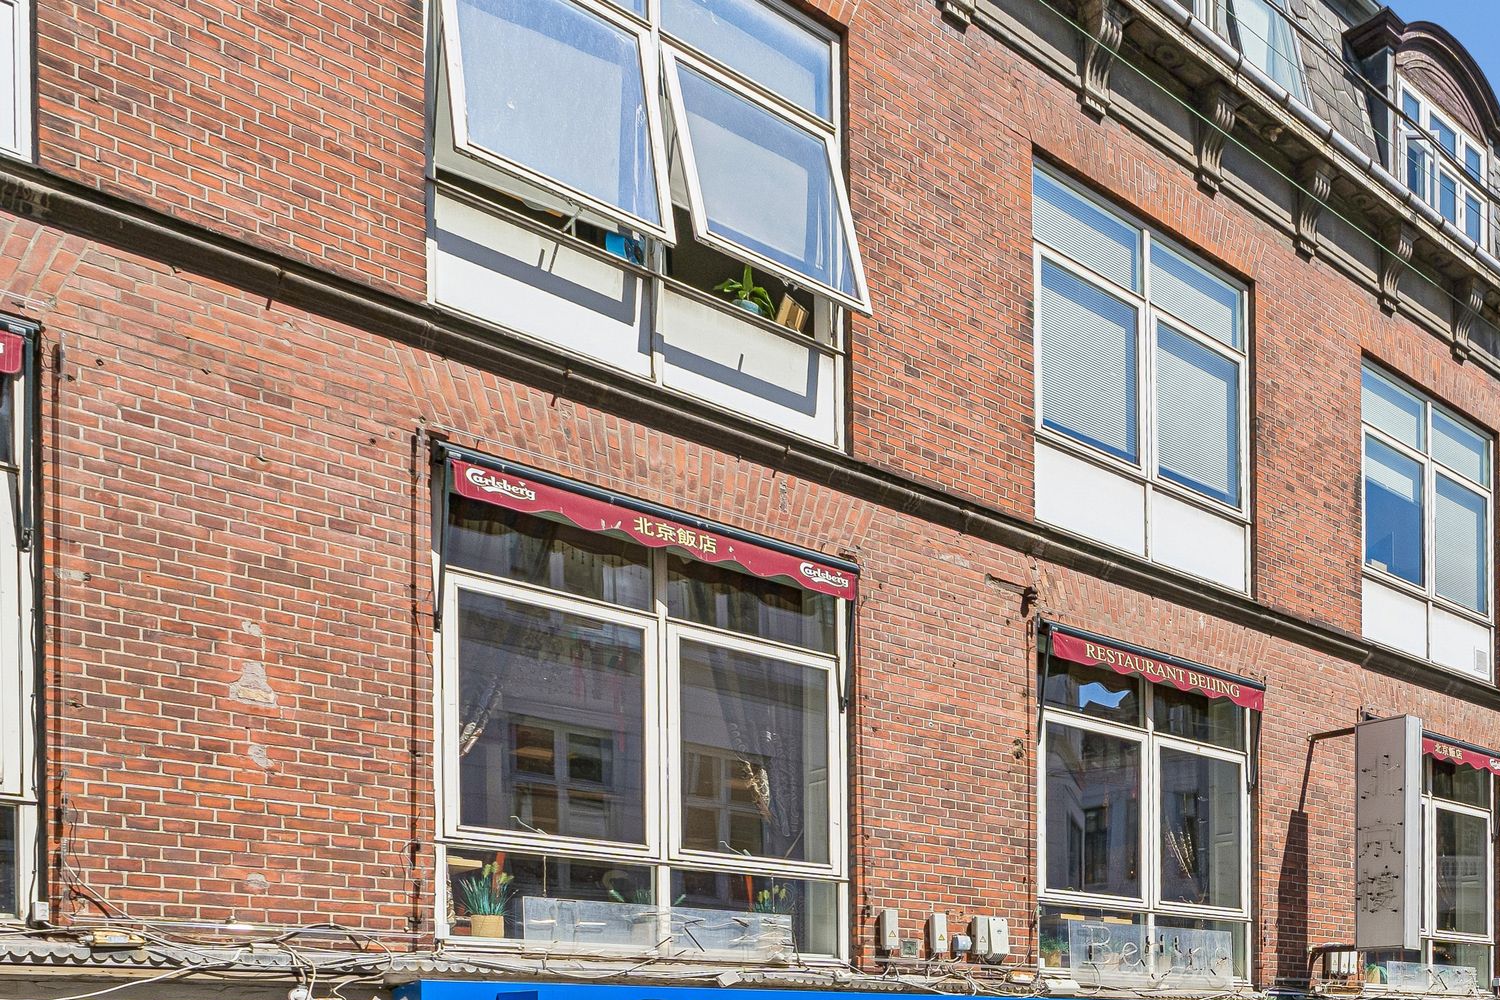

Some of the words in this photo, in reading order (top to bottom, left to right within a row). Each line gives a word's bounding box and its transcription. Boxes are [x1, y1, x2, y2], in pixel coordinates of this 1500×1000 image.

[465, 467, 536, 501] Carlsberg
[633, 516, 717, 554] 北京飯店
[799, 561, 849, 589] Carlsberg
[1085, 643, 1185, 683] RESTAURANT
[1189, 673, 1241, 698] BEIJING
